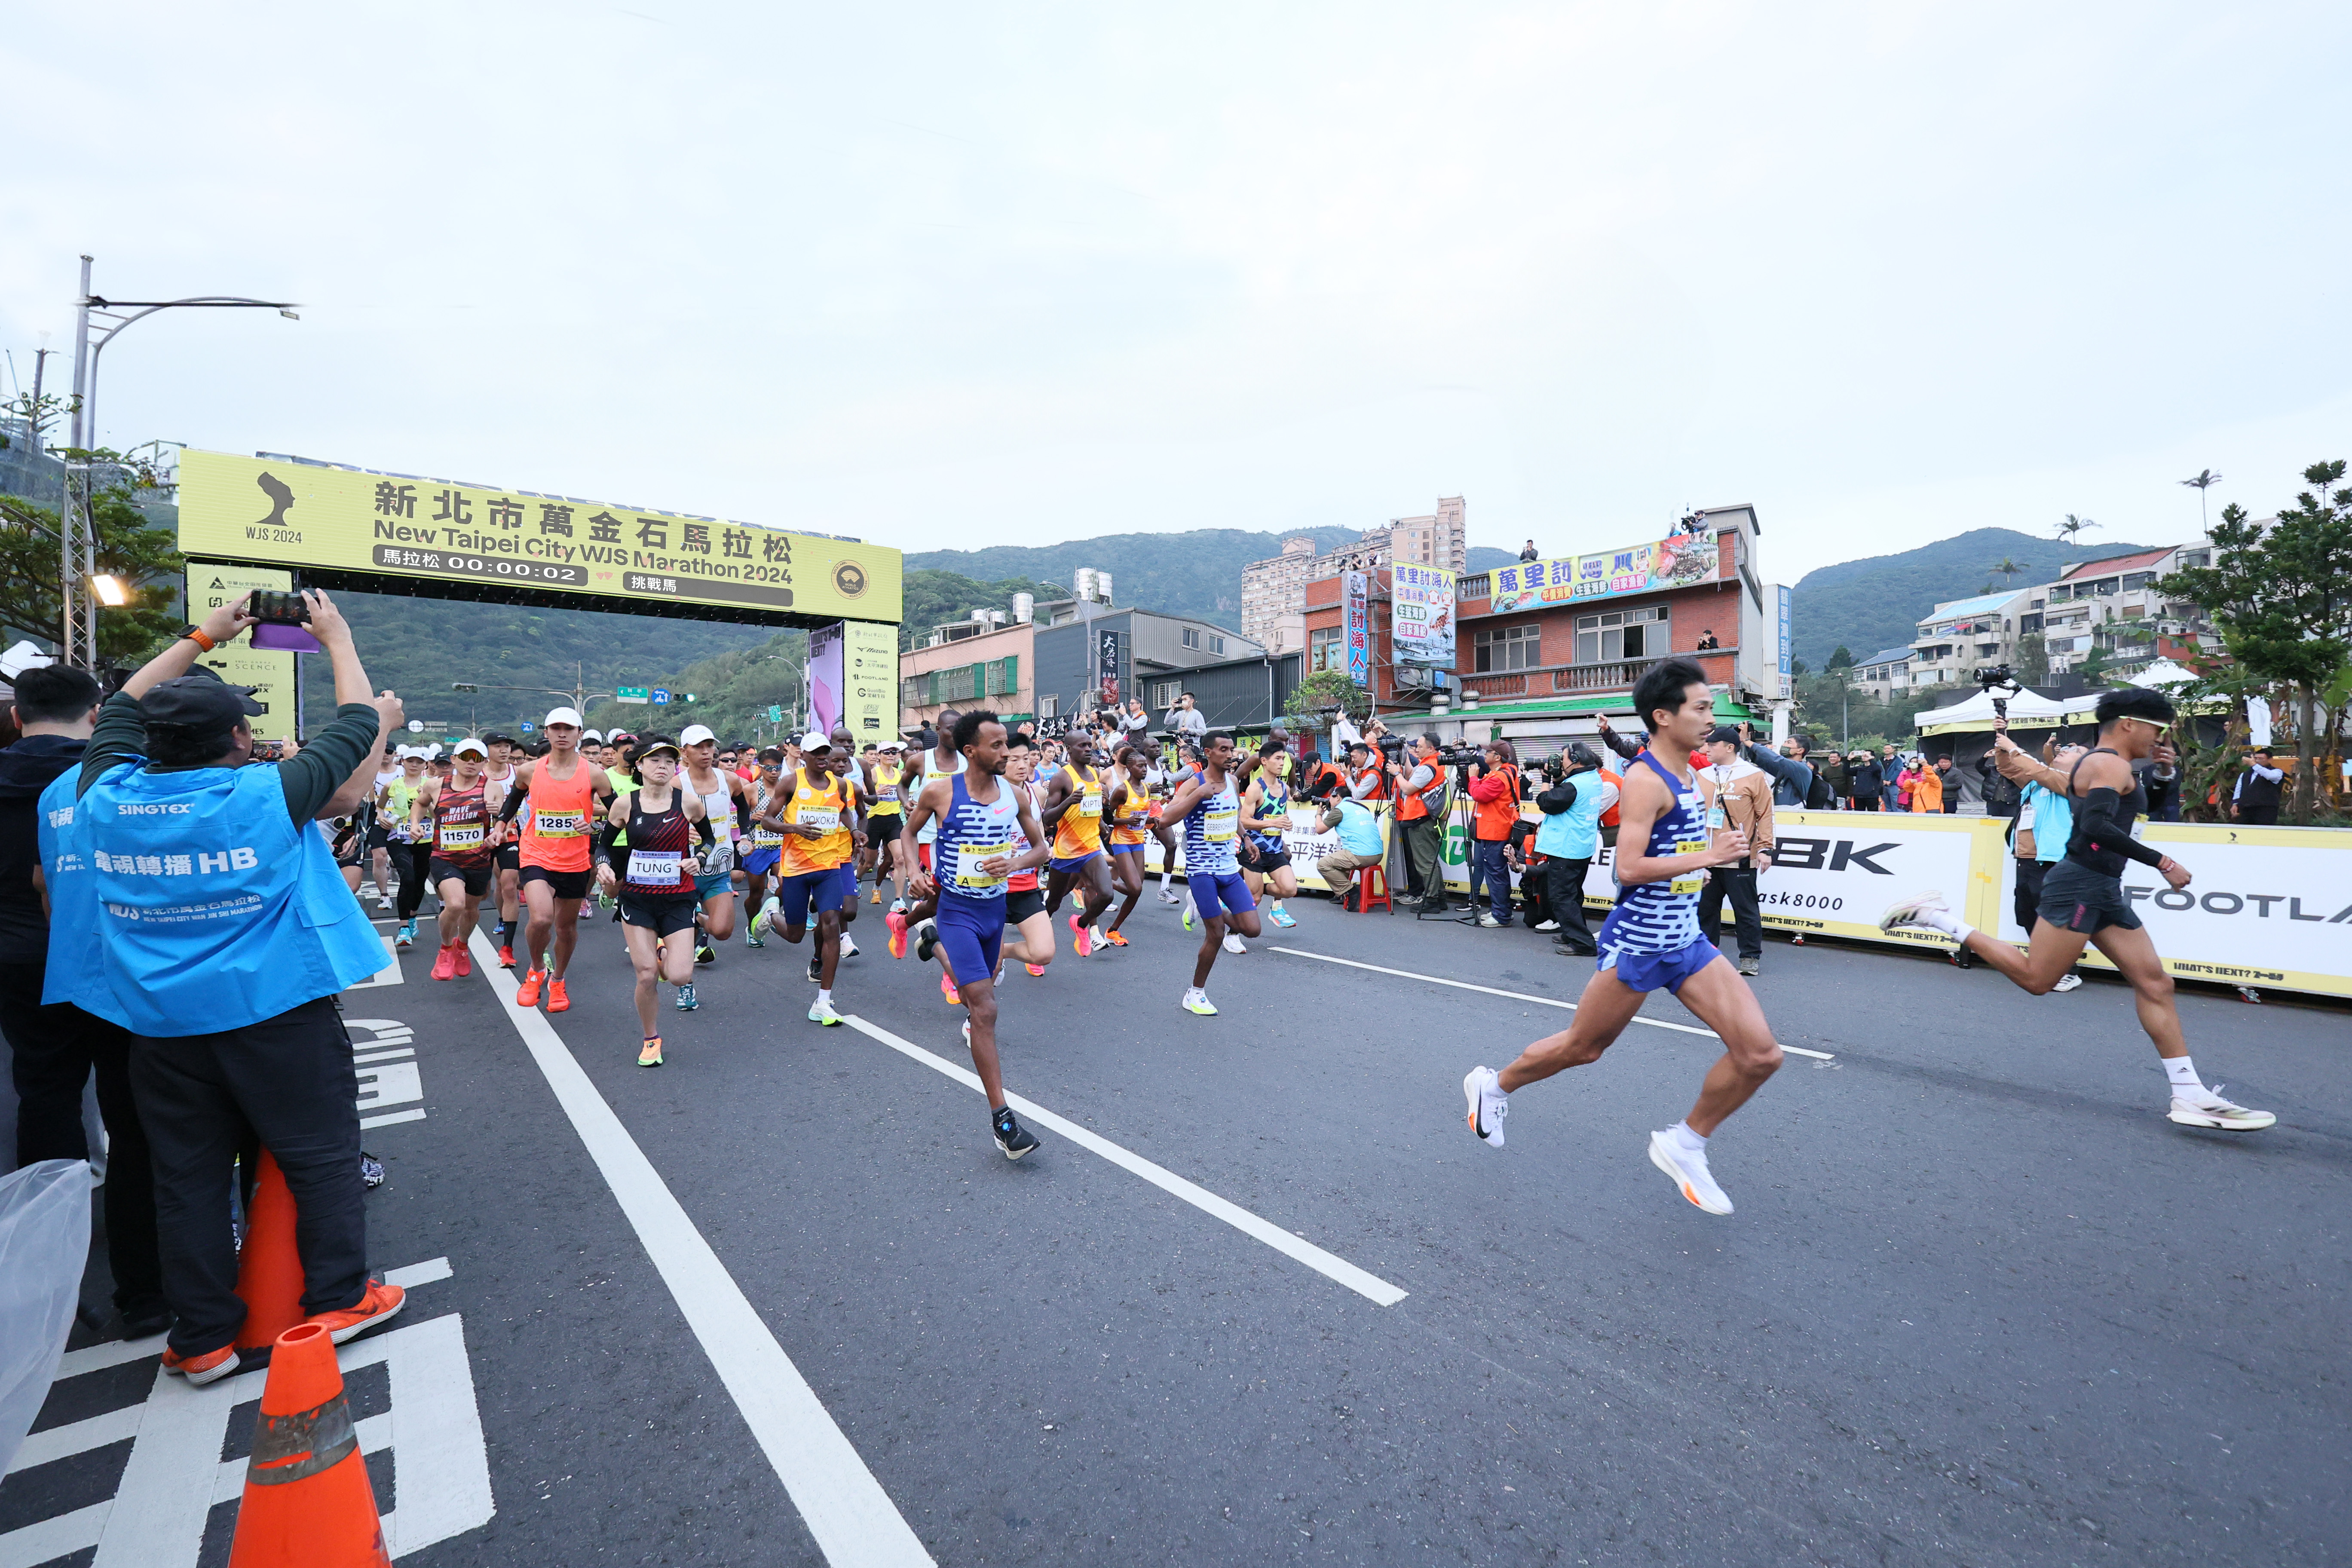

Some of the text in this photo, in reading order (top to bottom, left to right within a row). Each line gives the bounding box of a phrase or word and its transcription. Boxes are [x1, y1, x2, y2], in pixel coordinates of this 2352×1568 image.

[374, 481, 792, 565] 新北市萬金石馬拉松
[246, 526, 302, 544] WJS 2024
[374, 520, 793, 584] New Taipei City WJS Marathon 2024
[383, 549, 440, 568] 馬拉松
[448, 557, 576, 581] 00:00:02
[631, 575, 677, 593] 挑戰馬
[1396, 565, 1453, 590] 萬里討海人
[1612, 575, 1645, 590] 自家漁船
[1398, 588, 1424, 602] 平價消費
[1542, 587, 1572, 601] 平價消費
[1576, 582, 1608, 596] 生猛海鮮
[1350, 599, 1365, 609] 萬里
[1428, 590, 1453, 606] 食堂
[1398, 605, 1426, 620] 生猛海鮮
[1400, 623, 1427, 637] 自家漁船
[1351, 611, 1365, 669] 討海人
[118, 803, 190, 815] SINGTEX
[449, 805, 470, 815] WAVE
[441, 812, 478, 823] REBELLION
[540, 818, 578, 828] 1285
[800, 815, 835, 825] MOKOKA
[1207, 820, 1237, 831] GEBREYOHANNES
[444, 830, 479, 841] 11570
[94, 849, 192, 876] 電視轉播
[198, 847, 259, 875] HB
[635, 863, 671, 873] TUNG
[962, 877, 969, 885] A
[1676, 883, 1684, 893] A
[219, 910, 230, 918] SHI
[230, 903, 263, 916] MARATHON
[1783, 918, 1805, 926] NEXT?
[1884, 929, 1913, 939] WHAT'S
[1914, 931, 1939, 941] NEXT?
[2174, 962, 2213, 974] WHAT'S
[2216, 967, 2251, 977] NEXT?
